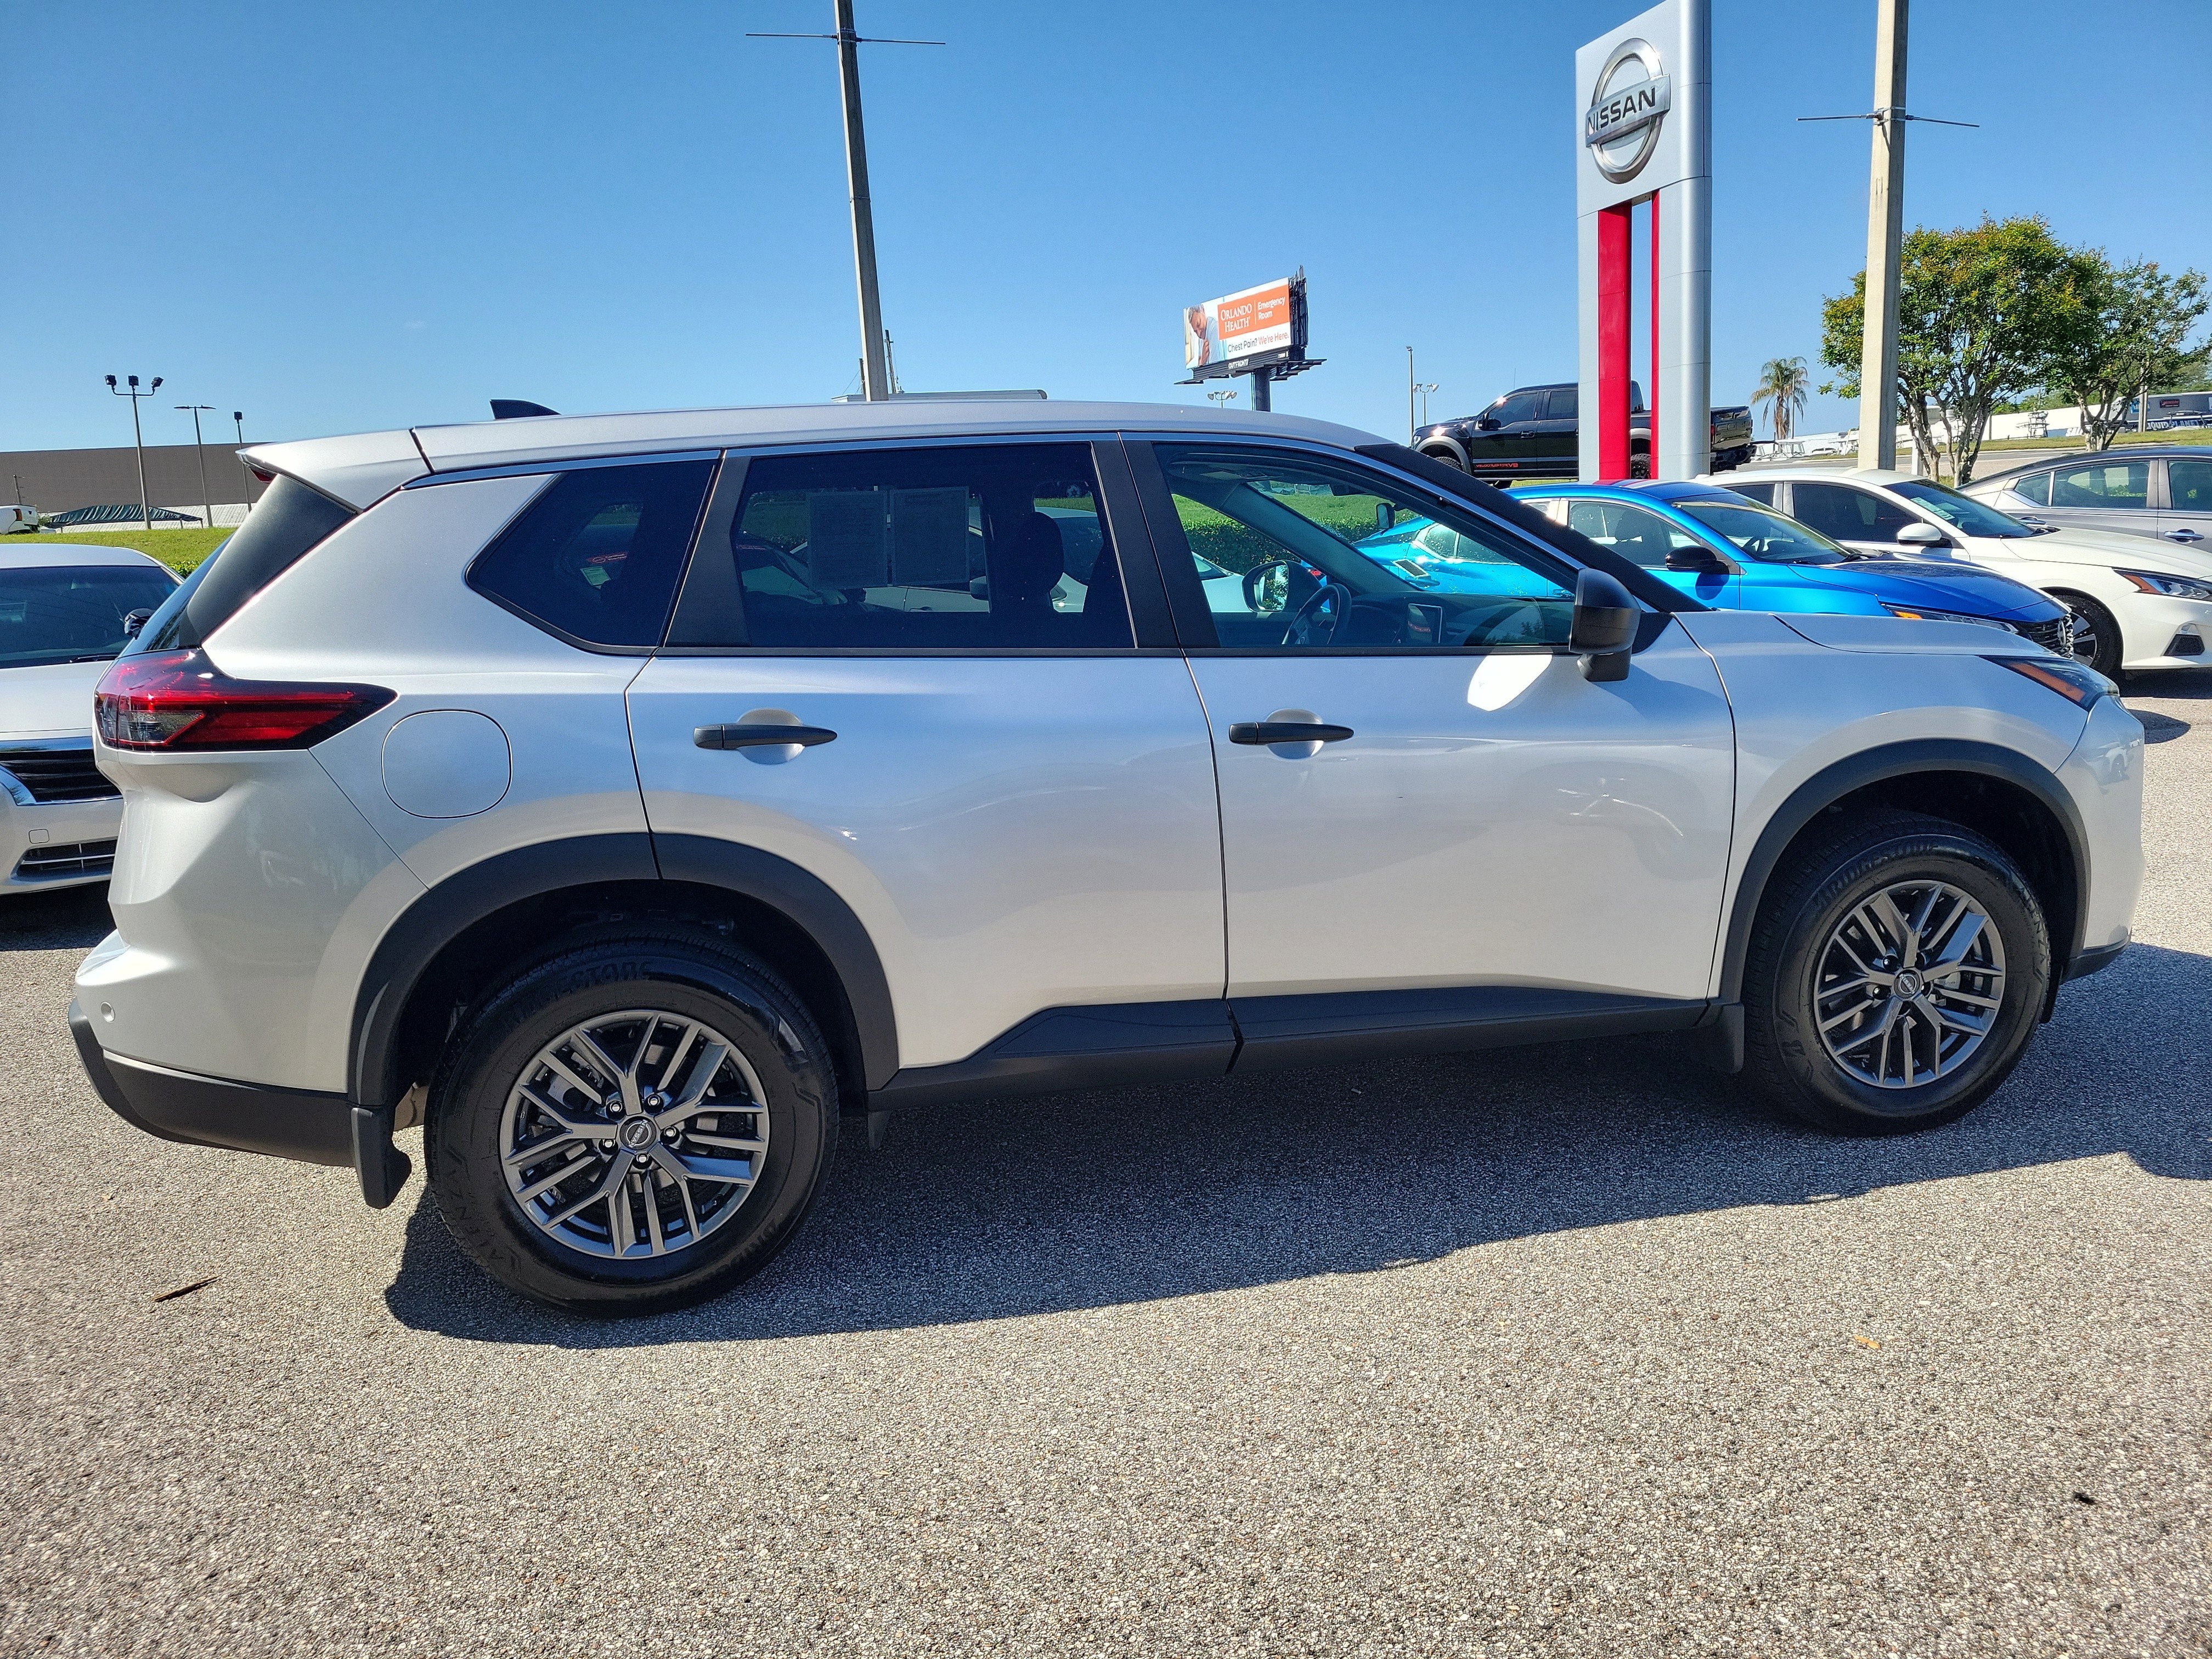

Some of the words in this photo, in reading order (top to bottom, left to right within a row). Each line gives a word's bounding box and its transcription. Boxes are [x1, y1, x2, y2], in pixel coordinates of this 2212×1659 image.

[1587, 87, 1656, 136] NISSAN
[1220, 303, 1252, 321] ORLANDO
[1257, 296, 1285, 311] Emergency
[1224, 317, 1250, 332] HEALTH
[1258, 311, 1273, 320] Room
[1228, 343, 1243, 353] Chest
[1243, 337, 1257, 349] Pain?
[1258, 335, 1273, 345] We're
[1274, 332, 1289, 341] Here.
[1899, 973, 1915, 995] NISSAN
[628, 1119, 648, 1148] NISSAN
